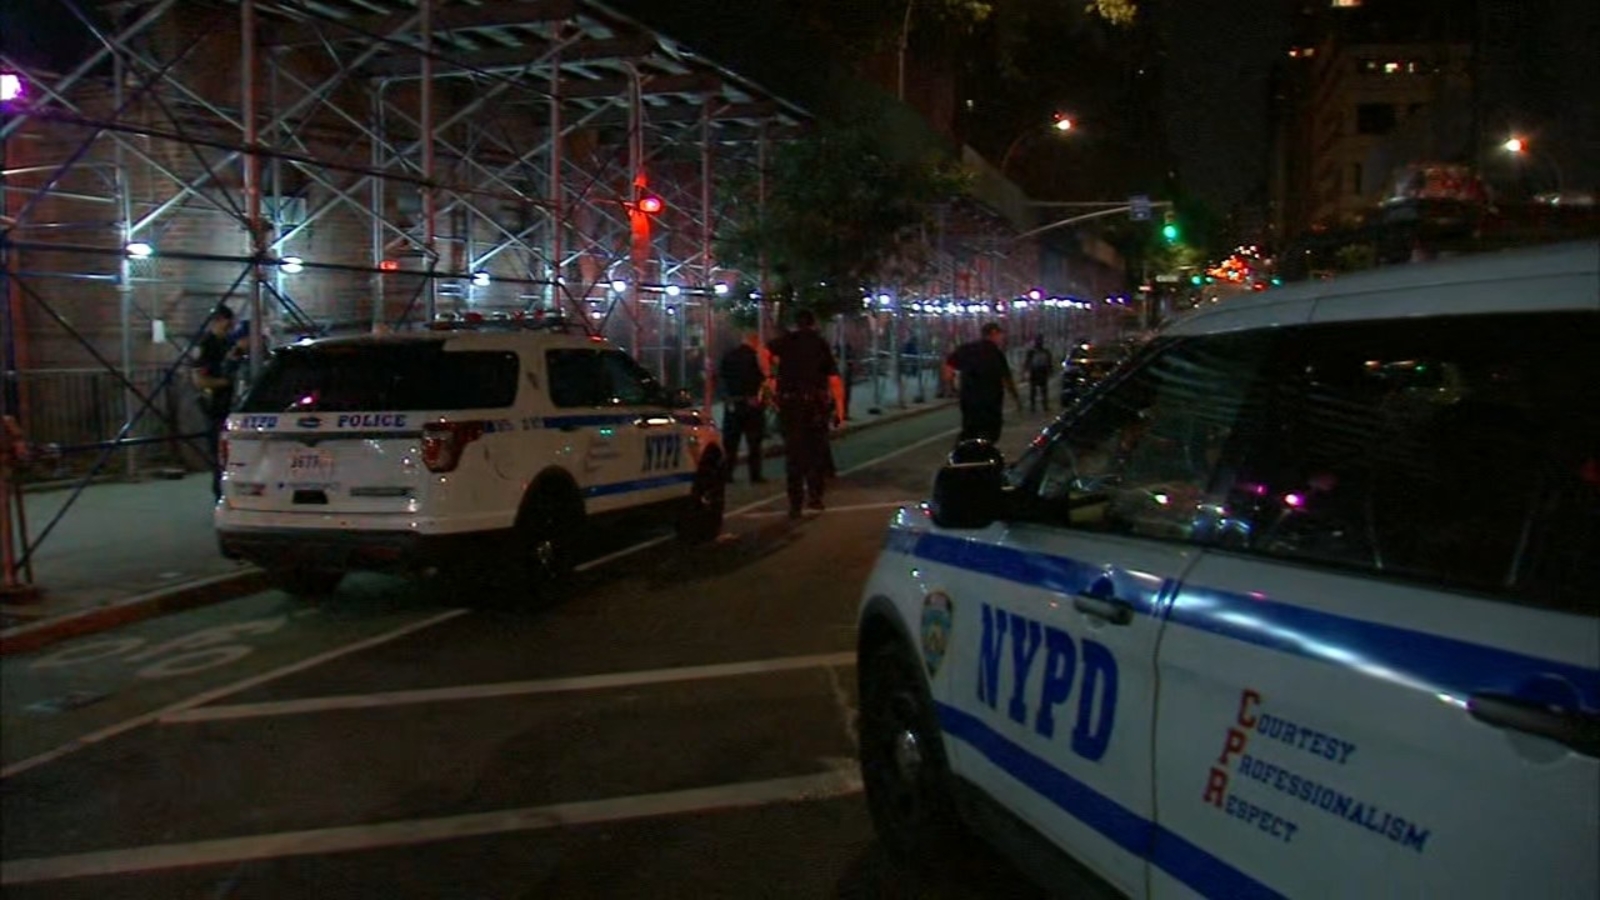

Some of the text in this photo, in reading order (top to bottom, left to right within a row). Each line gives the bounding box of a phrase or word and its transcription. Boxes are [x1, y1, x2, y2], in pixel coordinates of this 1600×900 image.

[337, 413, 408, 428] POLICE
[977, 602, 1119, 763] NYPD
[1237, 687, 1357, 765] COURTESY
[1202, 766, 1299, 844] RESPECT
[1218, 727, 1432, 854] PROFESSIONALISM
